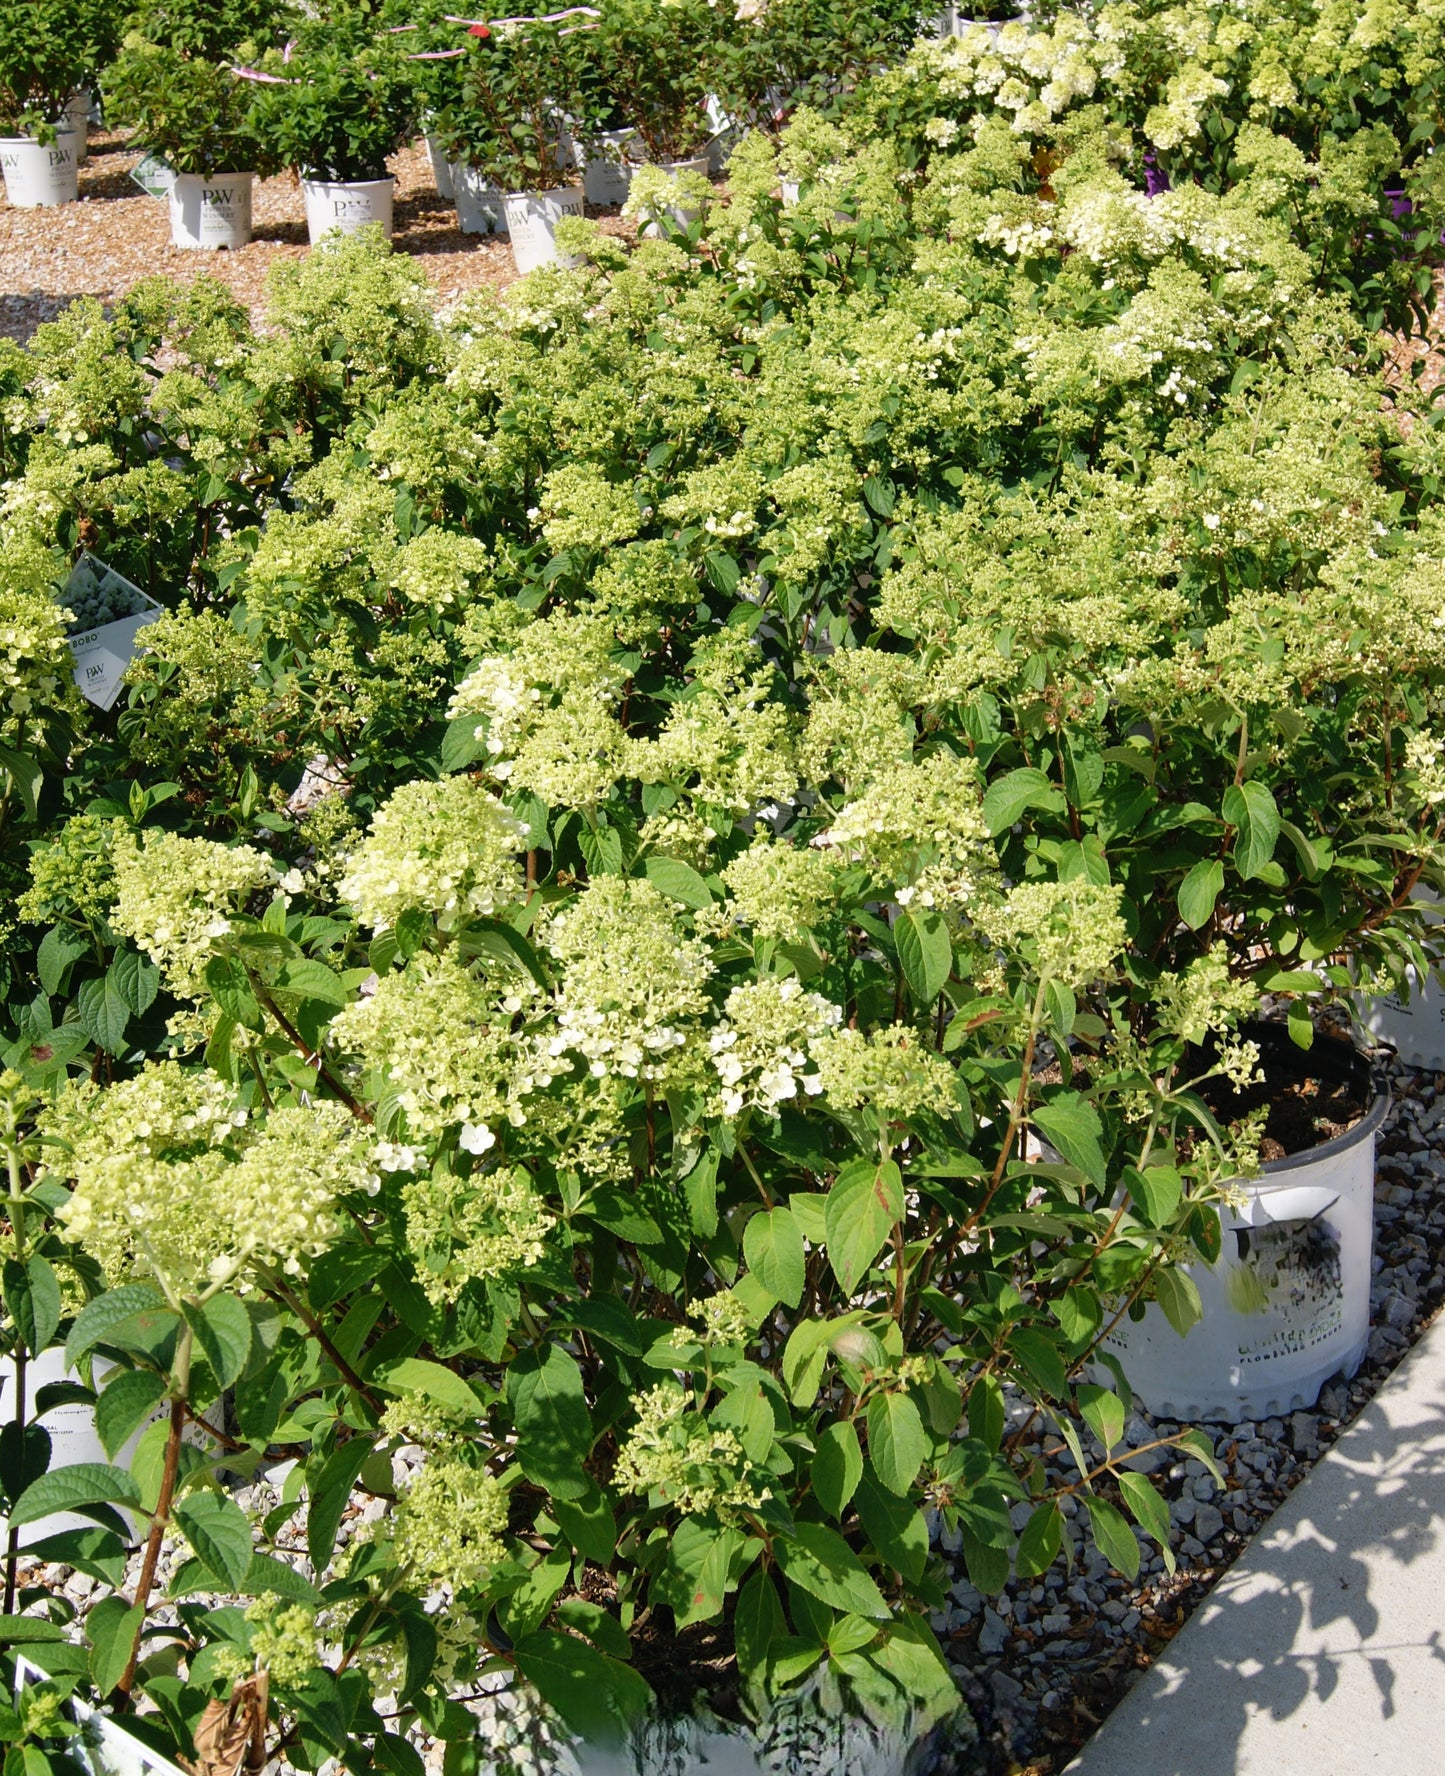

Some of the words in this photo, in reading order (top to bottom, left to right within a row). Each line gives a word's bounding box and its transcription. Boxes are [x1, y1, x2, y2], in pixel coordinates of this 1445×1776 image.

[48, 149, 72, 166] PW
[202, 189, 233, 205] PW
[72, 633, 98, 648] BOBO
[86, 663, 104, 679] PW
